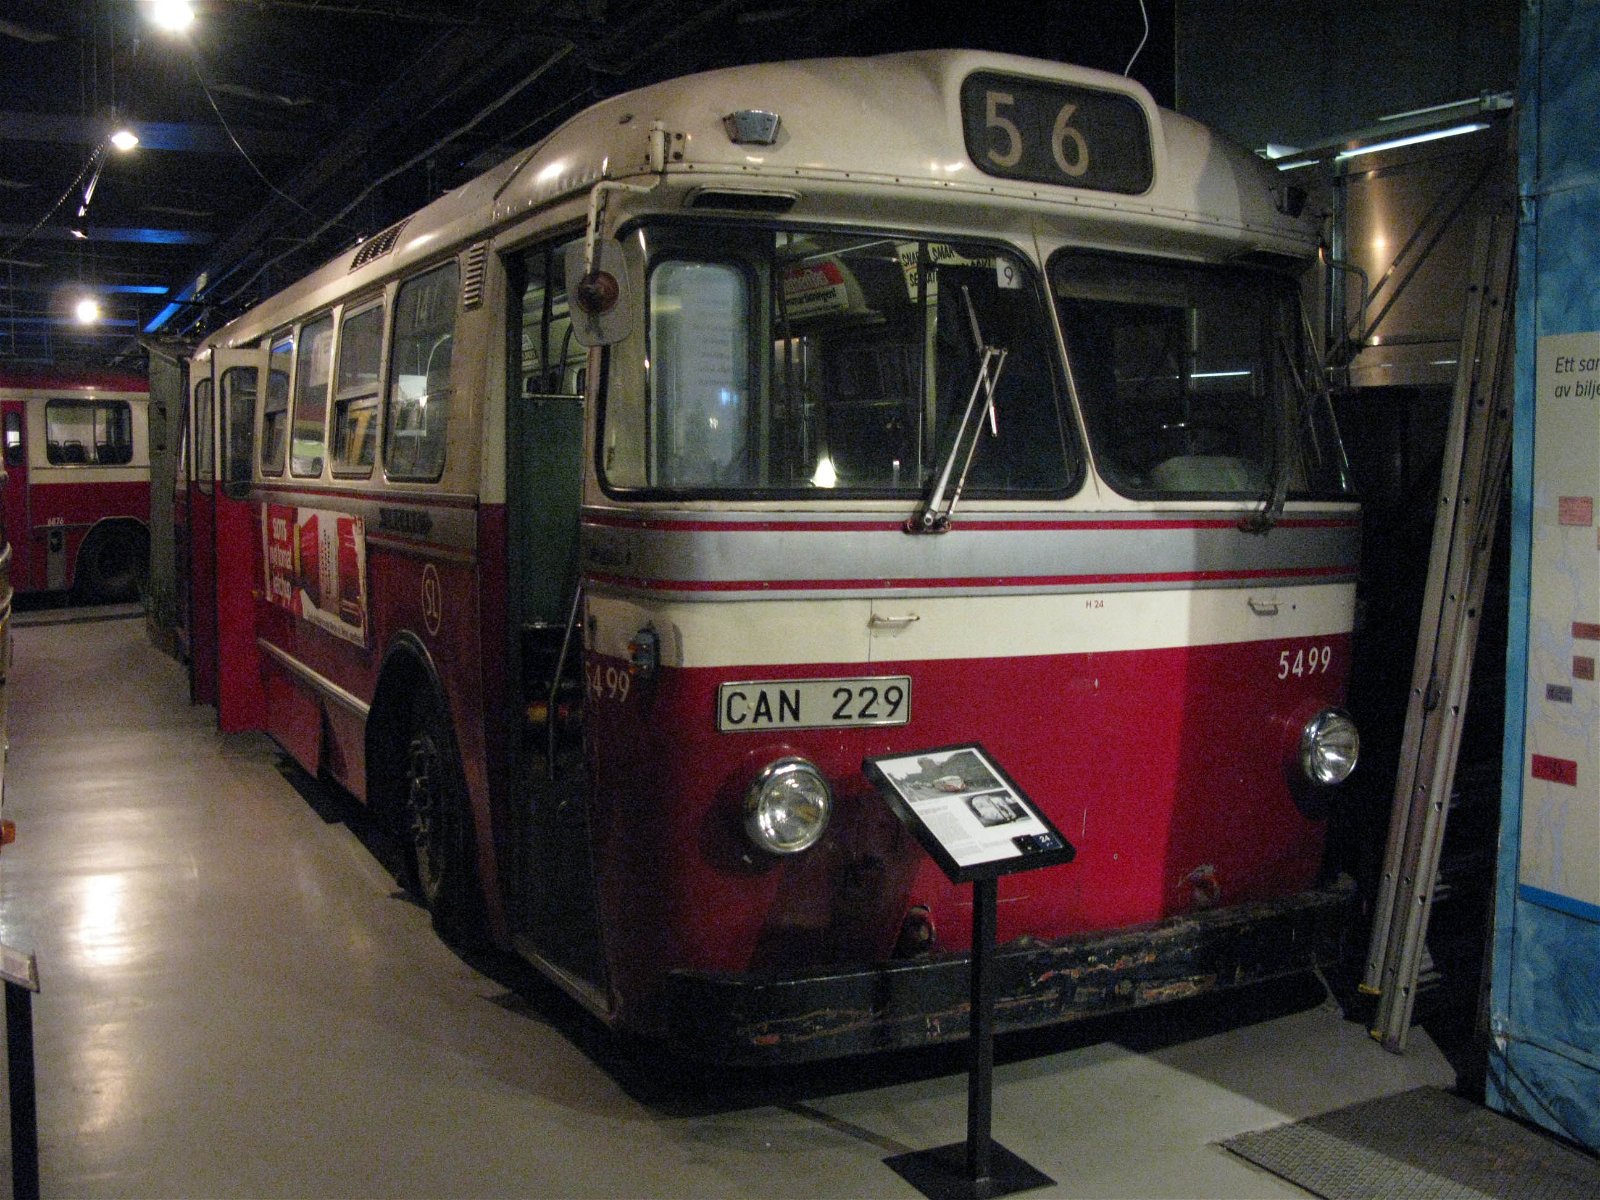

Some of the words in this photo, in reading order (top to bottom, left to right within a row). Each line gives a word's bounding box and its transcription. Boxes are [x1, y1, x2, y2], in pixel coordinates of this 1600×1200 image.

[985, 90, 1090, 177] 56
[1555, 356, 1575, 373] Ett
[1554, 385, 1571, 398] av
[1085, 600, 1092, 609] H
[1094, 600, 1104, 609] 24
[1278, 645, 1331, 680] 5499
[726, 688, 800, 724] CAN
[831, 685, 904, 720] 229
[1039, 834, 1051, 843] 24
